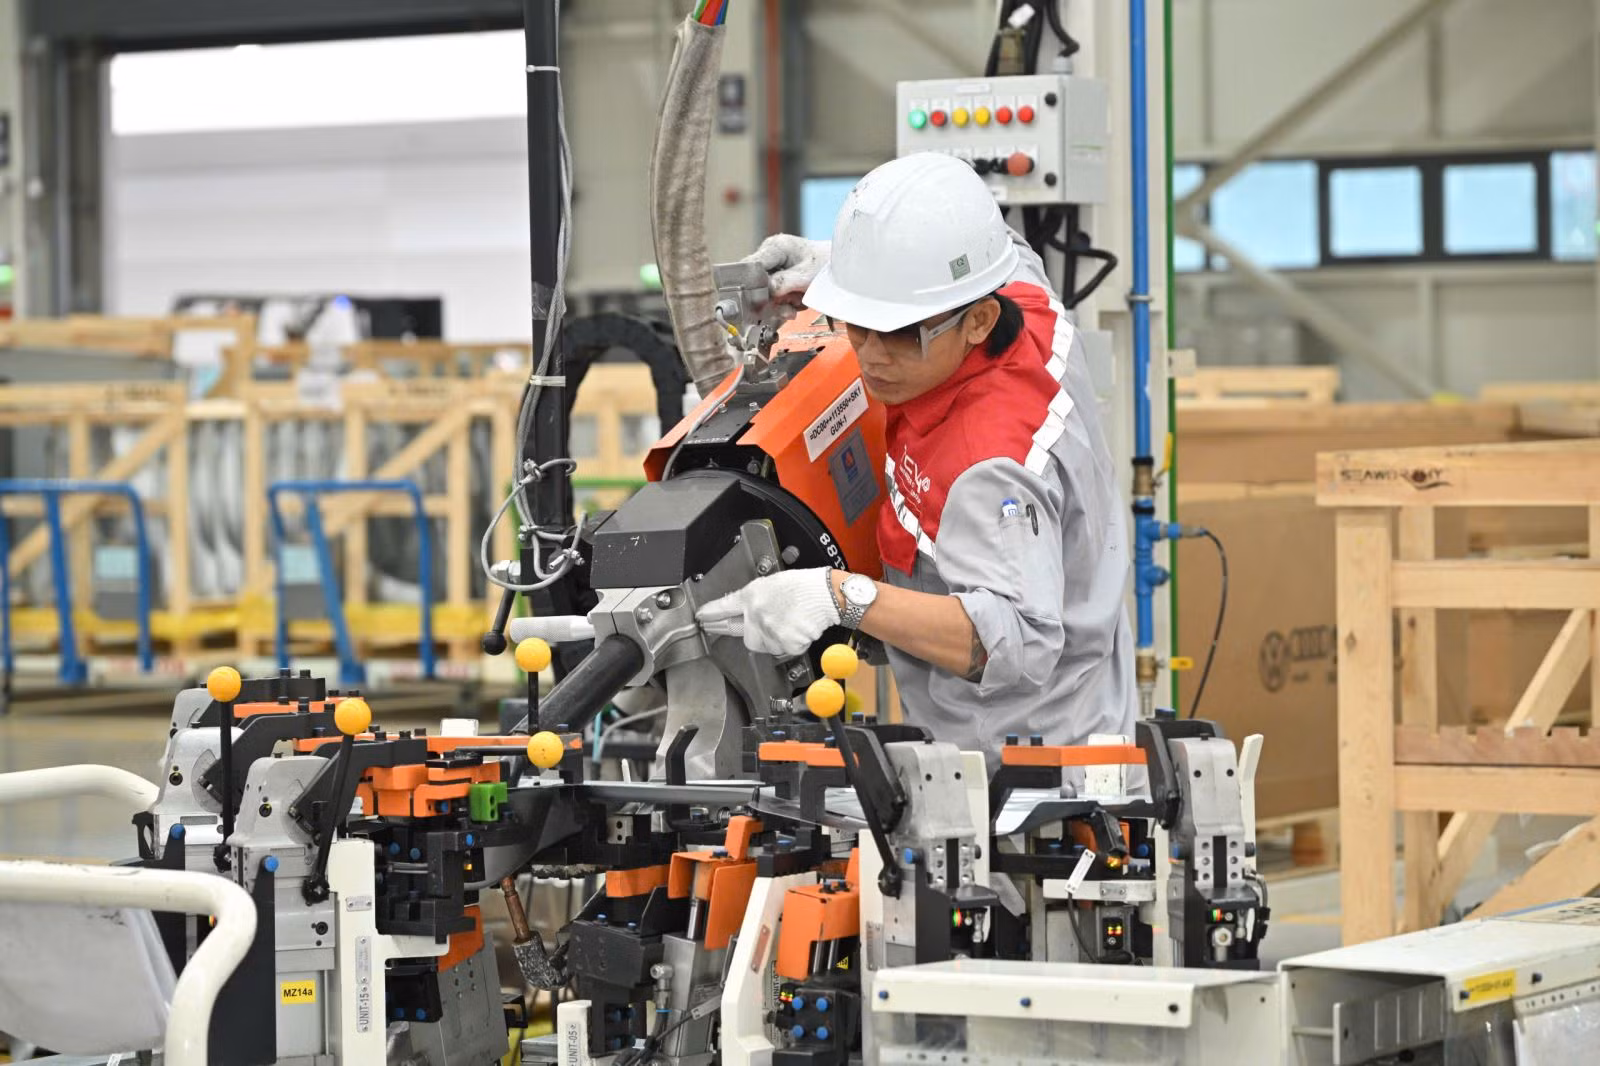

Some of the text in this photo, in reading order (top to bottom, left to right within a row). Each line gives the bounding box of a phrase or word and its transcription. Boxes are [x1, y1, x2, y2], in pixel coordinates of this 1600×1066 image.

[830, 415, 848, 436] GUN-1
[283, 988, 313, 998] MZ14a
[359, 993, 369, 1025] UNIT-15
[568, 1030, 578, 1063] UNIT-05
